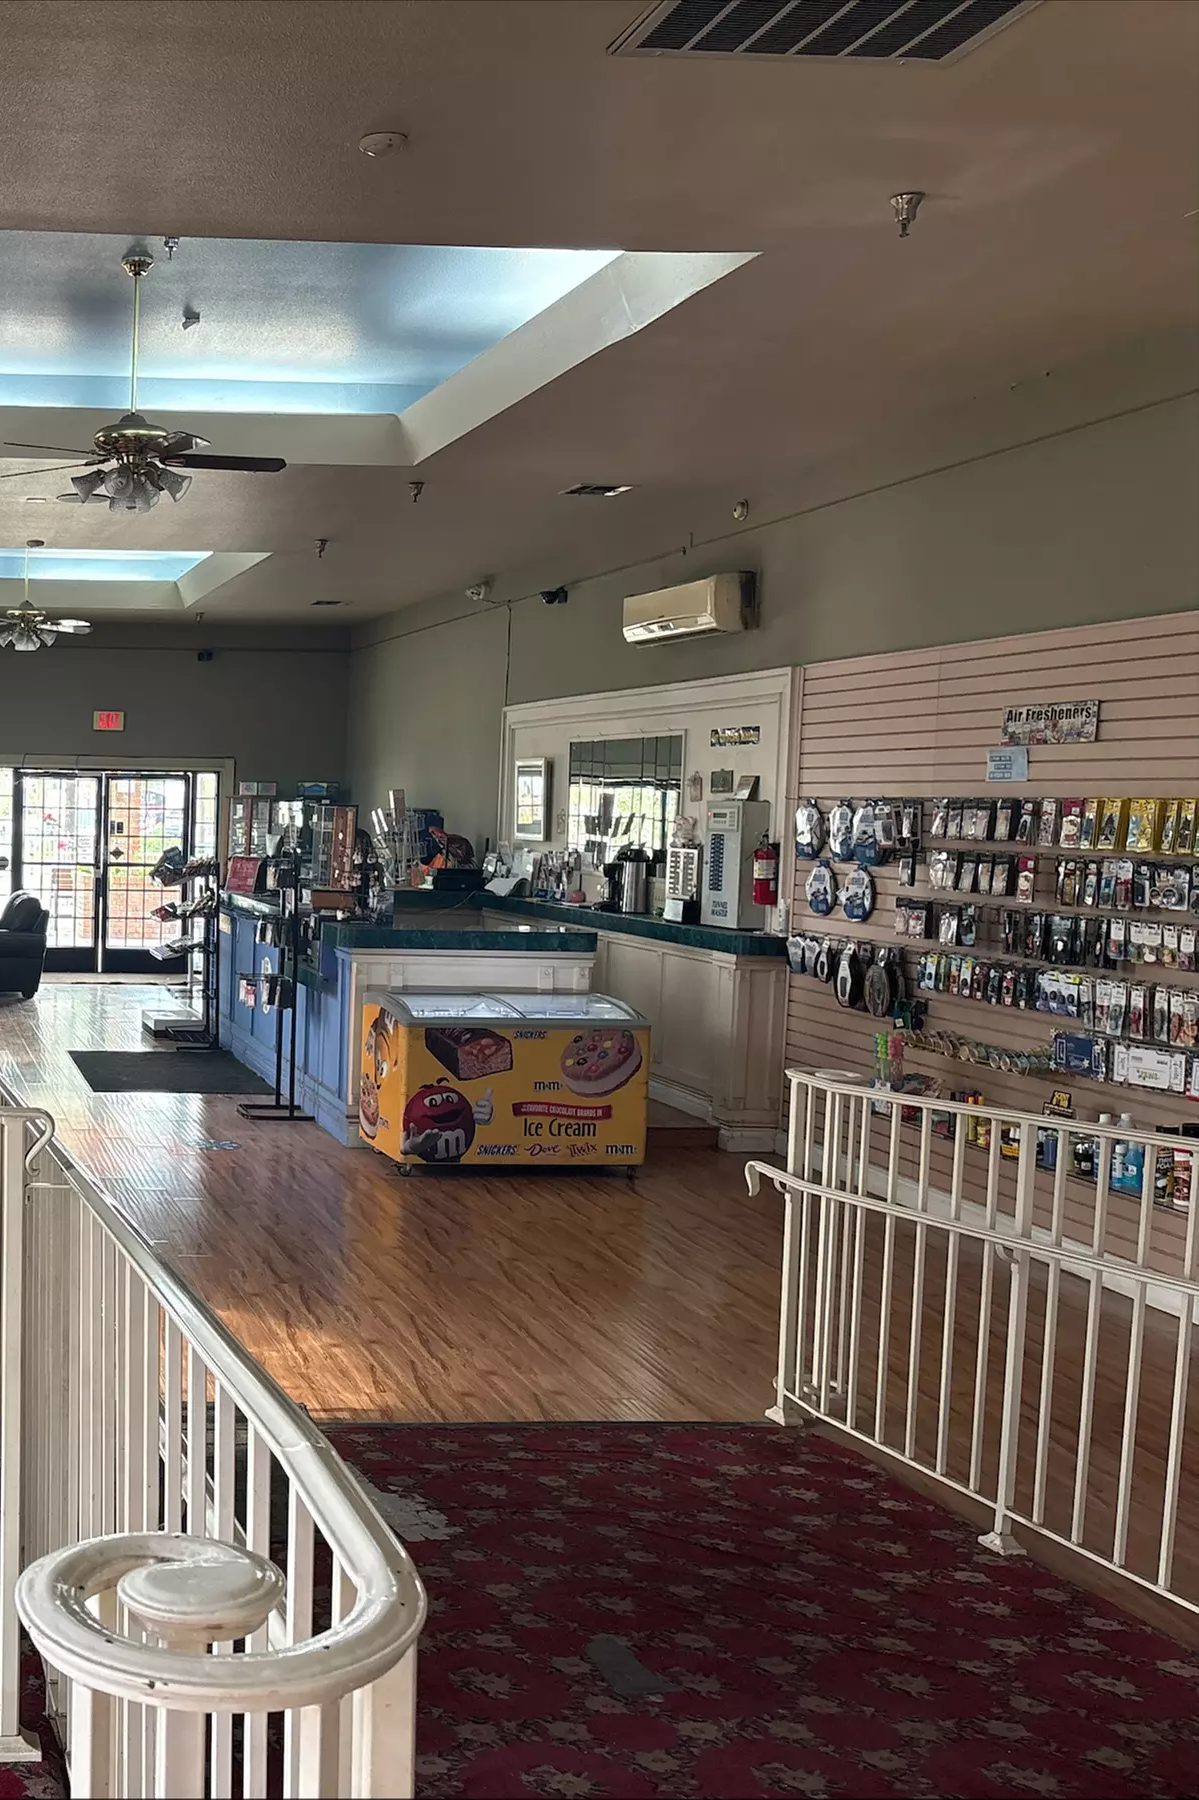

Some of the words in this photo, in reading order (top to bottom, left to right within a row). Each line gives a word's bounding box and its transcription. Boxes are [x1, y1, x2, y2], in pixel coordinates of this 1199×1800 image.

[98, 712, 120, 728] EXIT
[1006, 709, 1023, 722] Air
[1025, 706, 1092, 722] Fresheners
[513, 1030, 547, 1040] SNICKERS
[524, 1118, 543, 1136] Ice
[549, 1118, 596, 1137] Cream
[476, 1143, 519, 1156] SNICKERS
